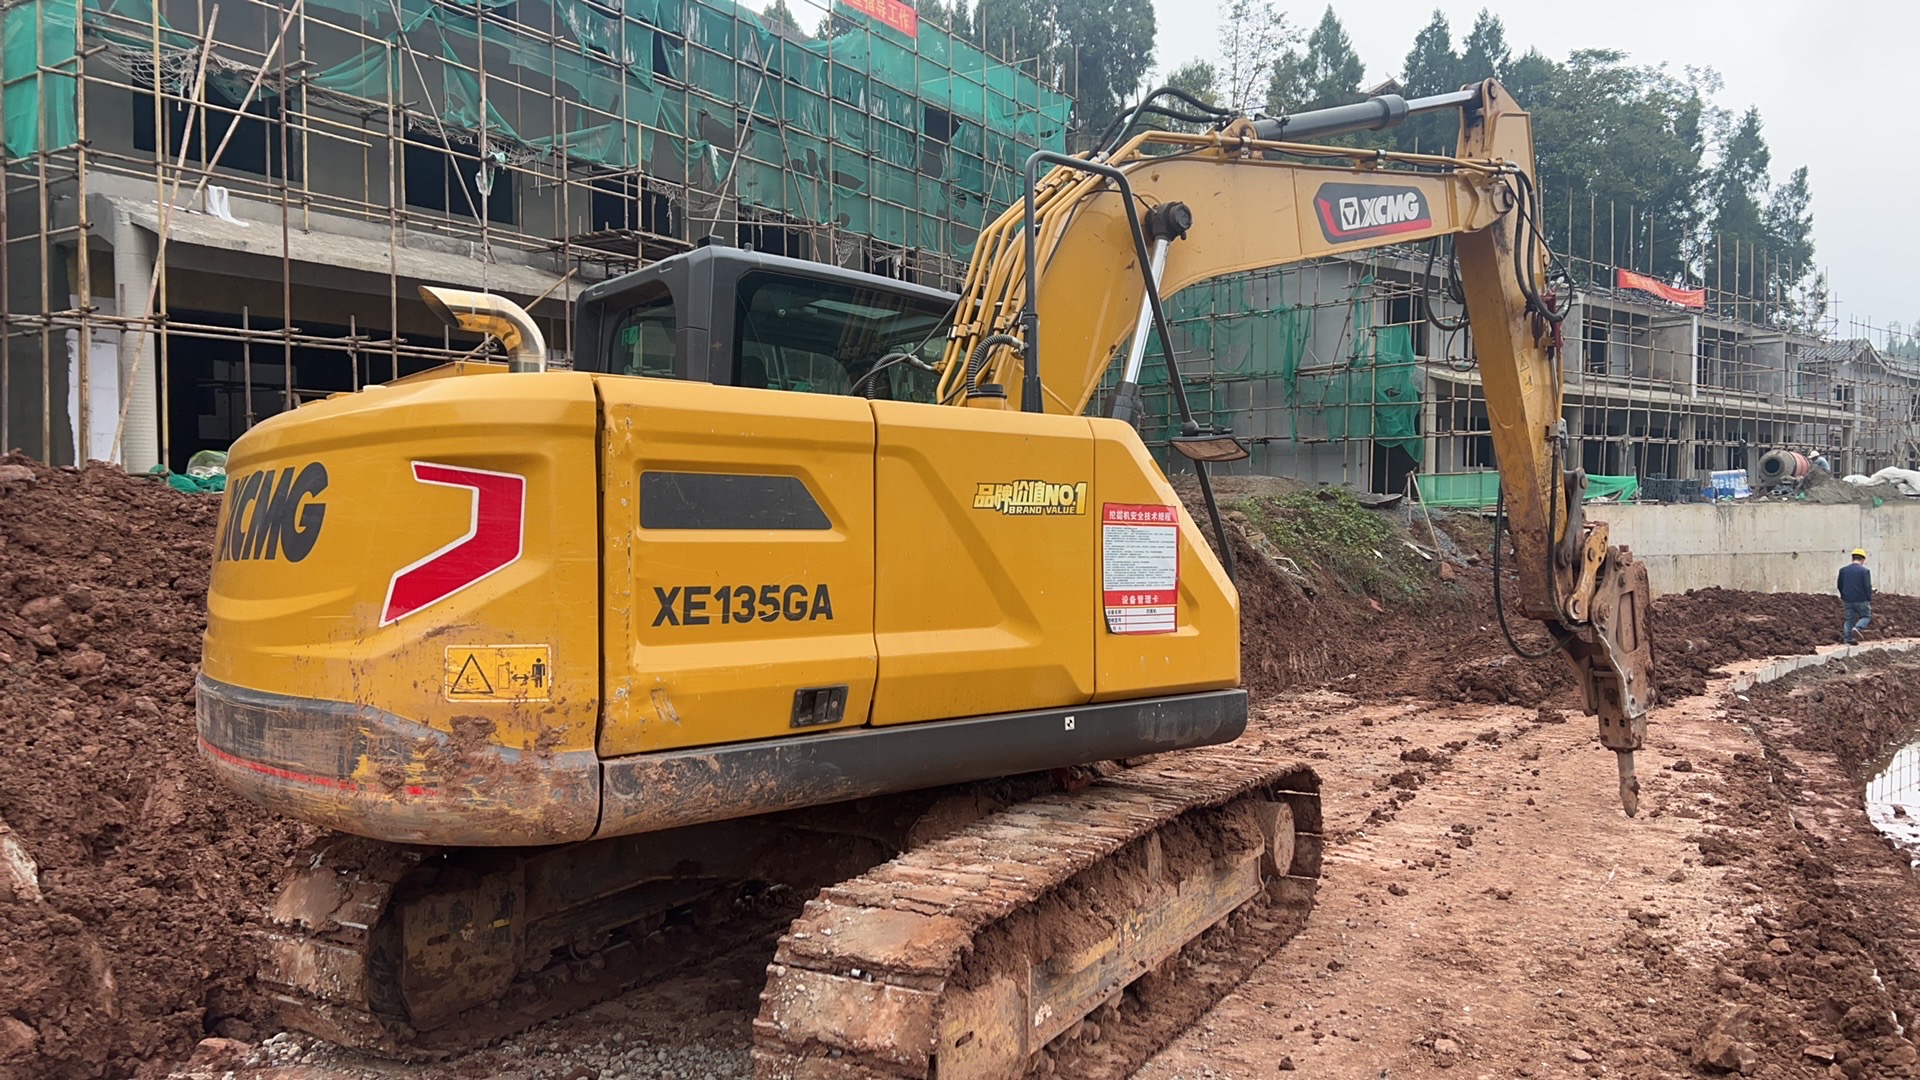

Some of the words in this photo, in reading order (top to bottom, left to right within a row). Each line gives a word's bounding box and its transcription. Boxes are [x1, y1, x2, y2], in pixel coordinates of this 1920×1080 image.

[852, 0, 910, 30] 指导工作
[1360, 191, 1420, 228] XCMG
[217, 461, 329, 563] XCMG
[1008, 506, 1043, 515] BRAND
[1046, 506, 1076, 515] VALUE
[1109, 510, 1172, 522] 挖掘机安全技术规程
[651, 583, 834, 627] XE135GA
[1121, 594, 1160, 605] 设备管理卡
